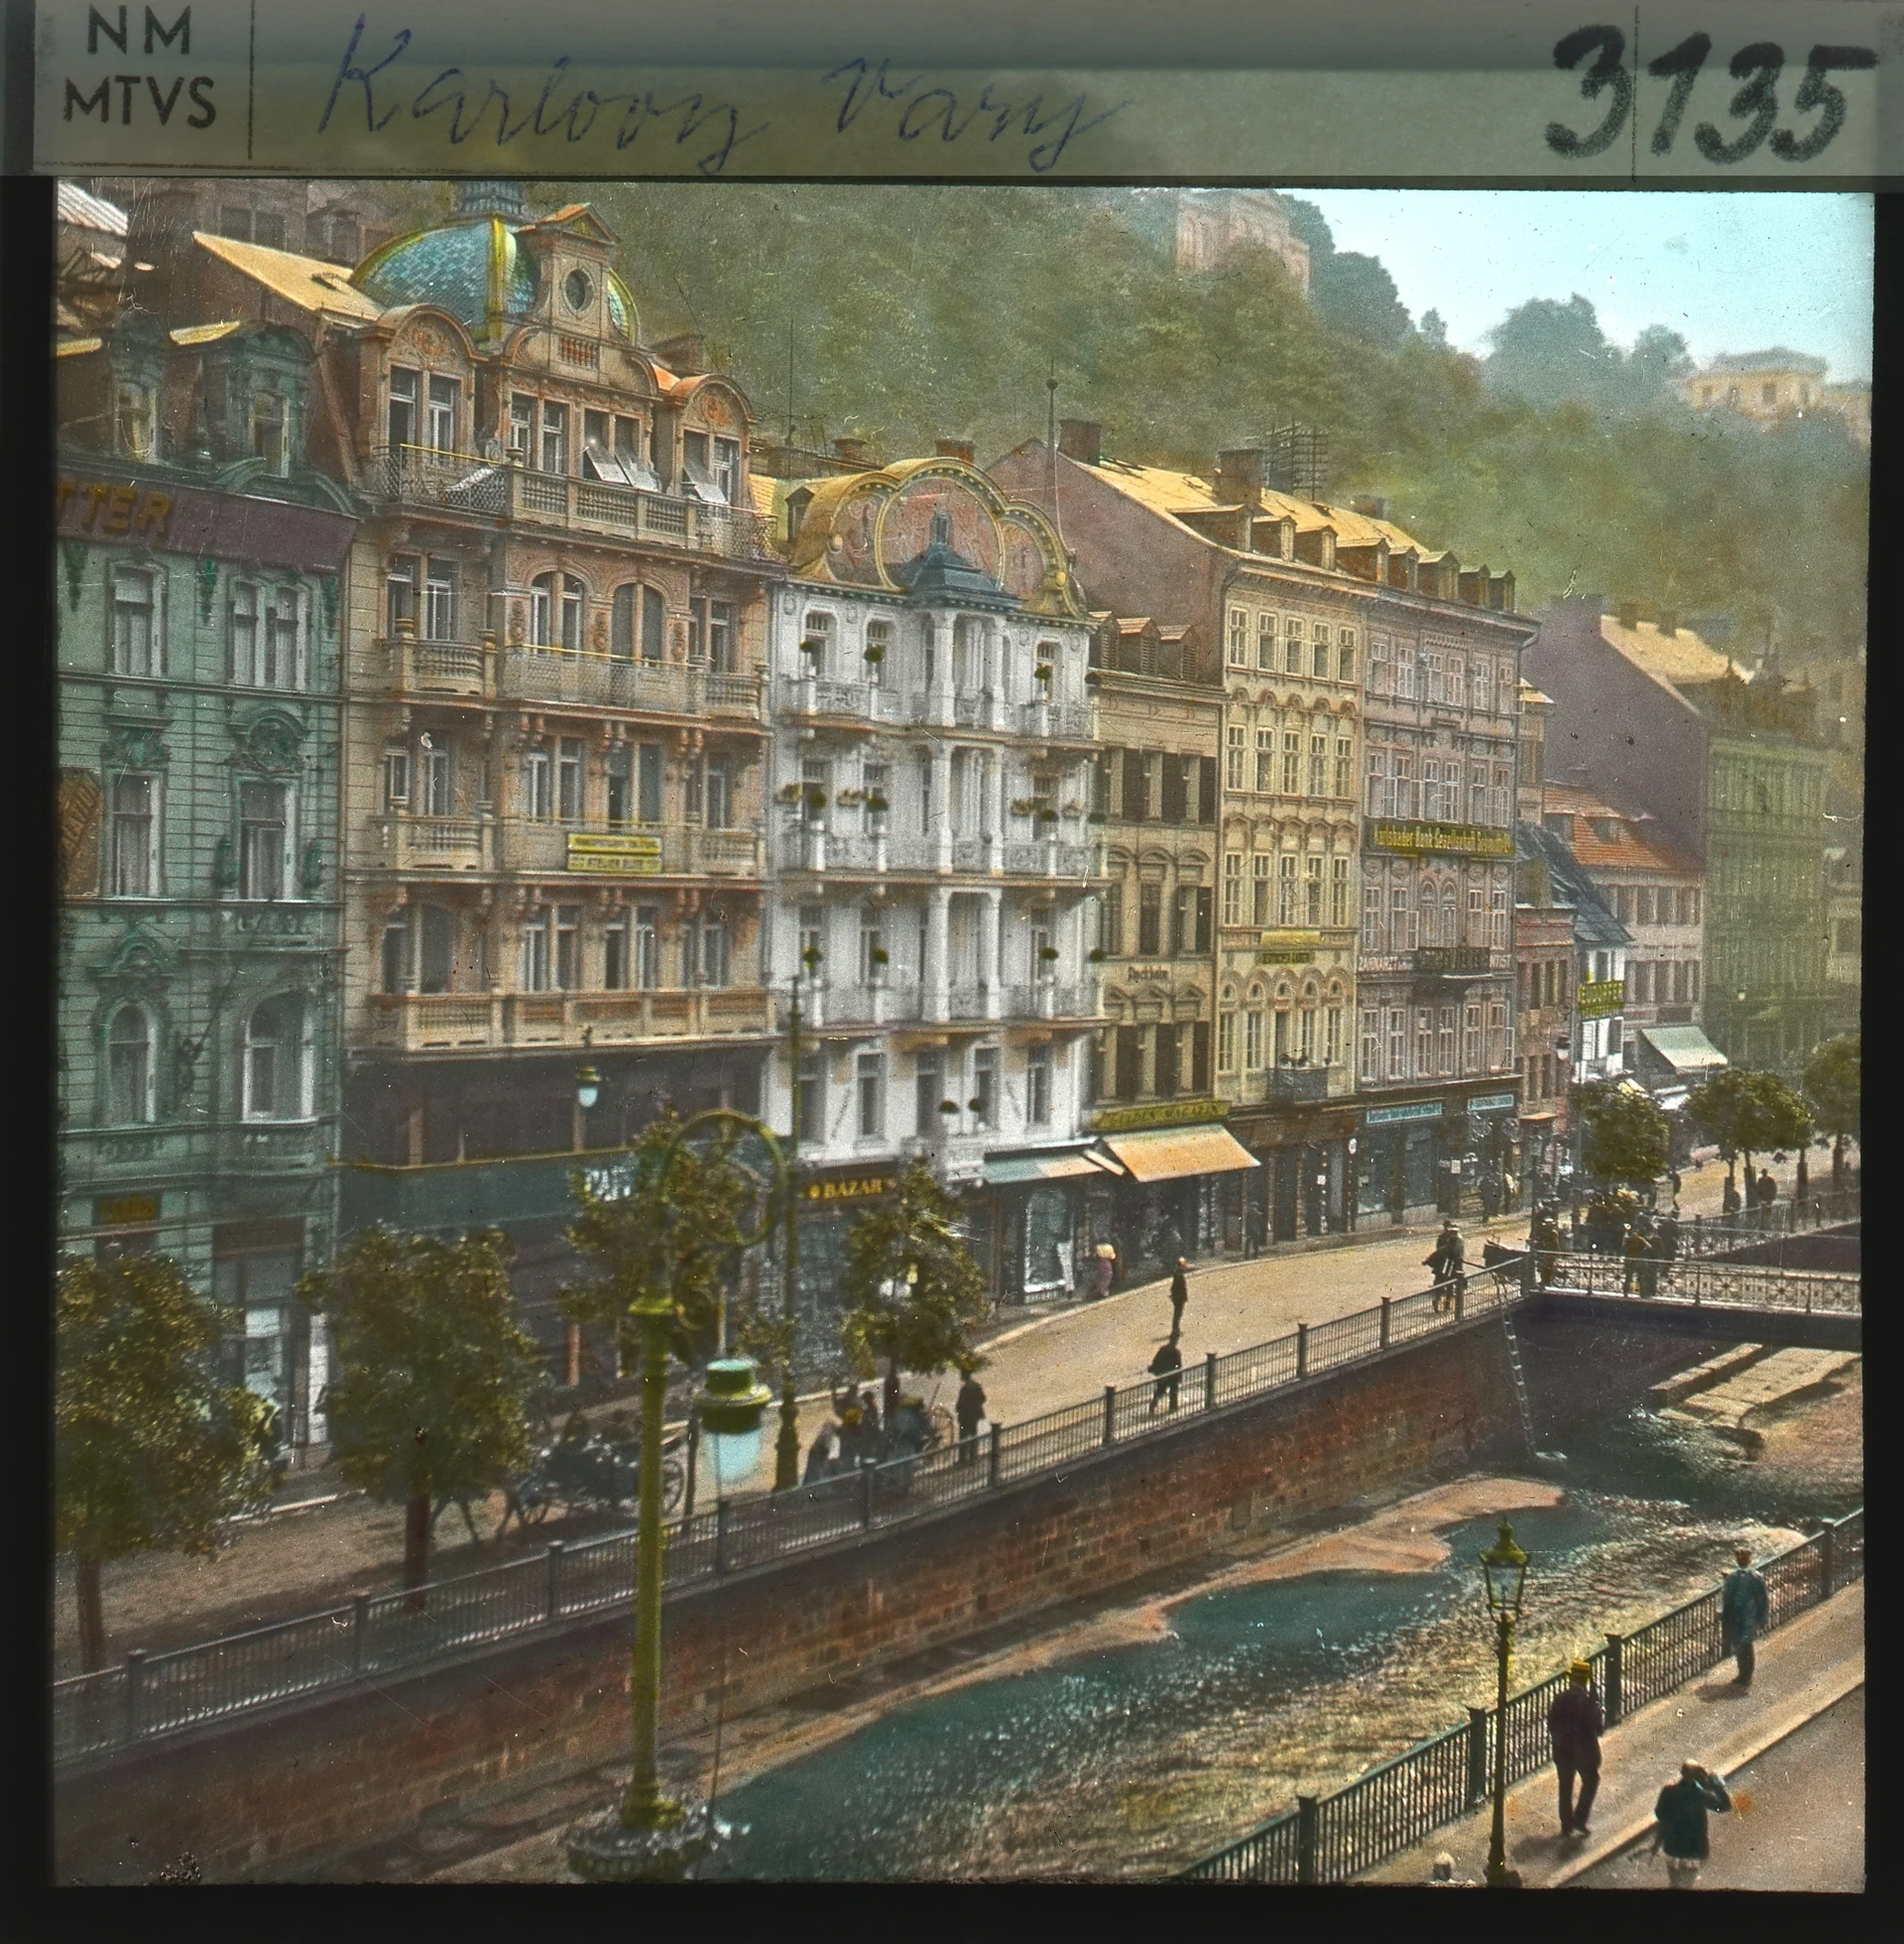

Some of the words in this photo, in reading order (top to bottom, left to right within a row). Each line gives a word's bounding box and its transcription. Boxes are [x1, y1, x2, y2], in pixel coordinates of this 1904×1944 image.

[61, 75, 218, 130] MTVS
[317, 12, 773, 177] Karlovy
[819, 56, 1133, 174] Vary
[1544, 23, 1878, 166] 3135
[823, 1177, 883, 1199] BAZAR
